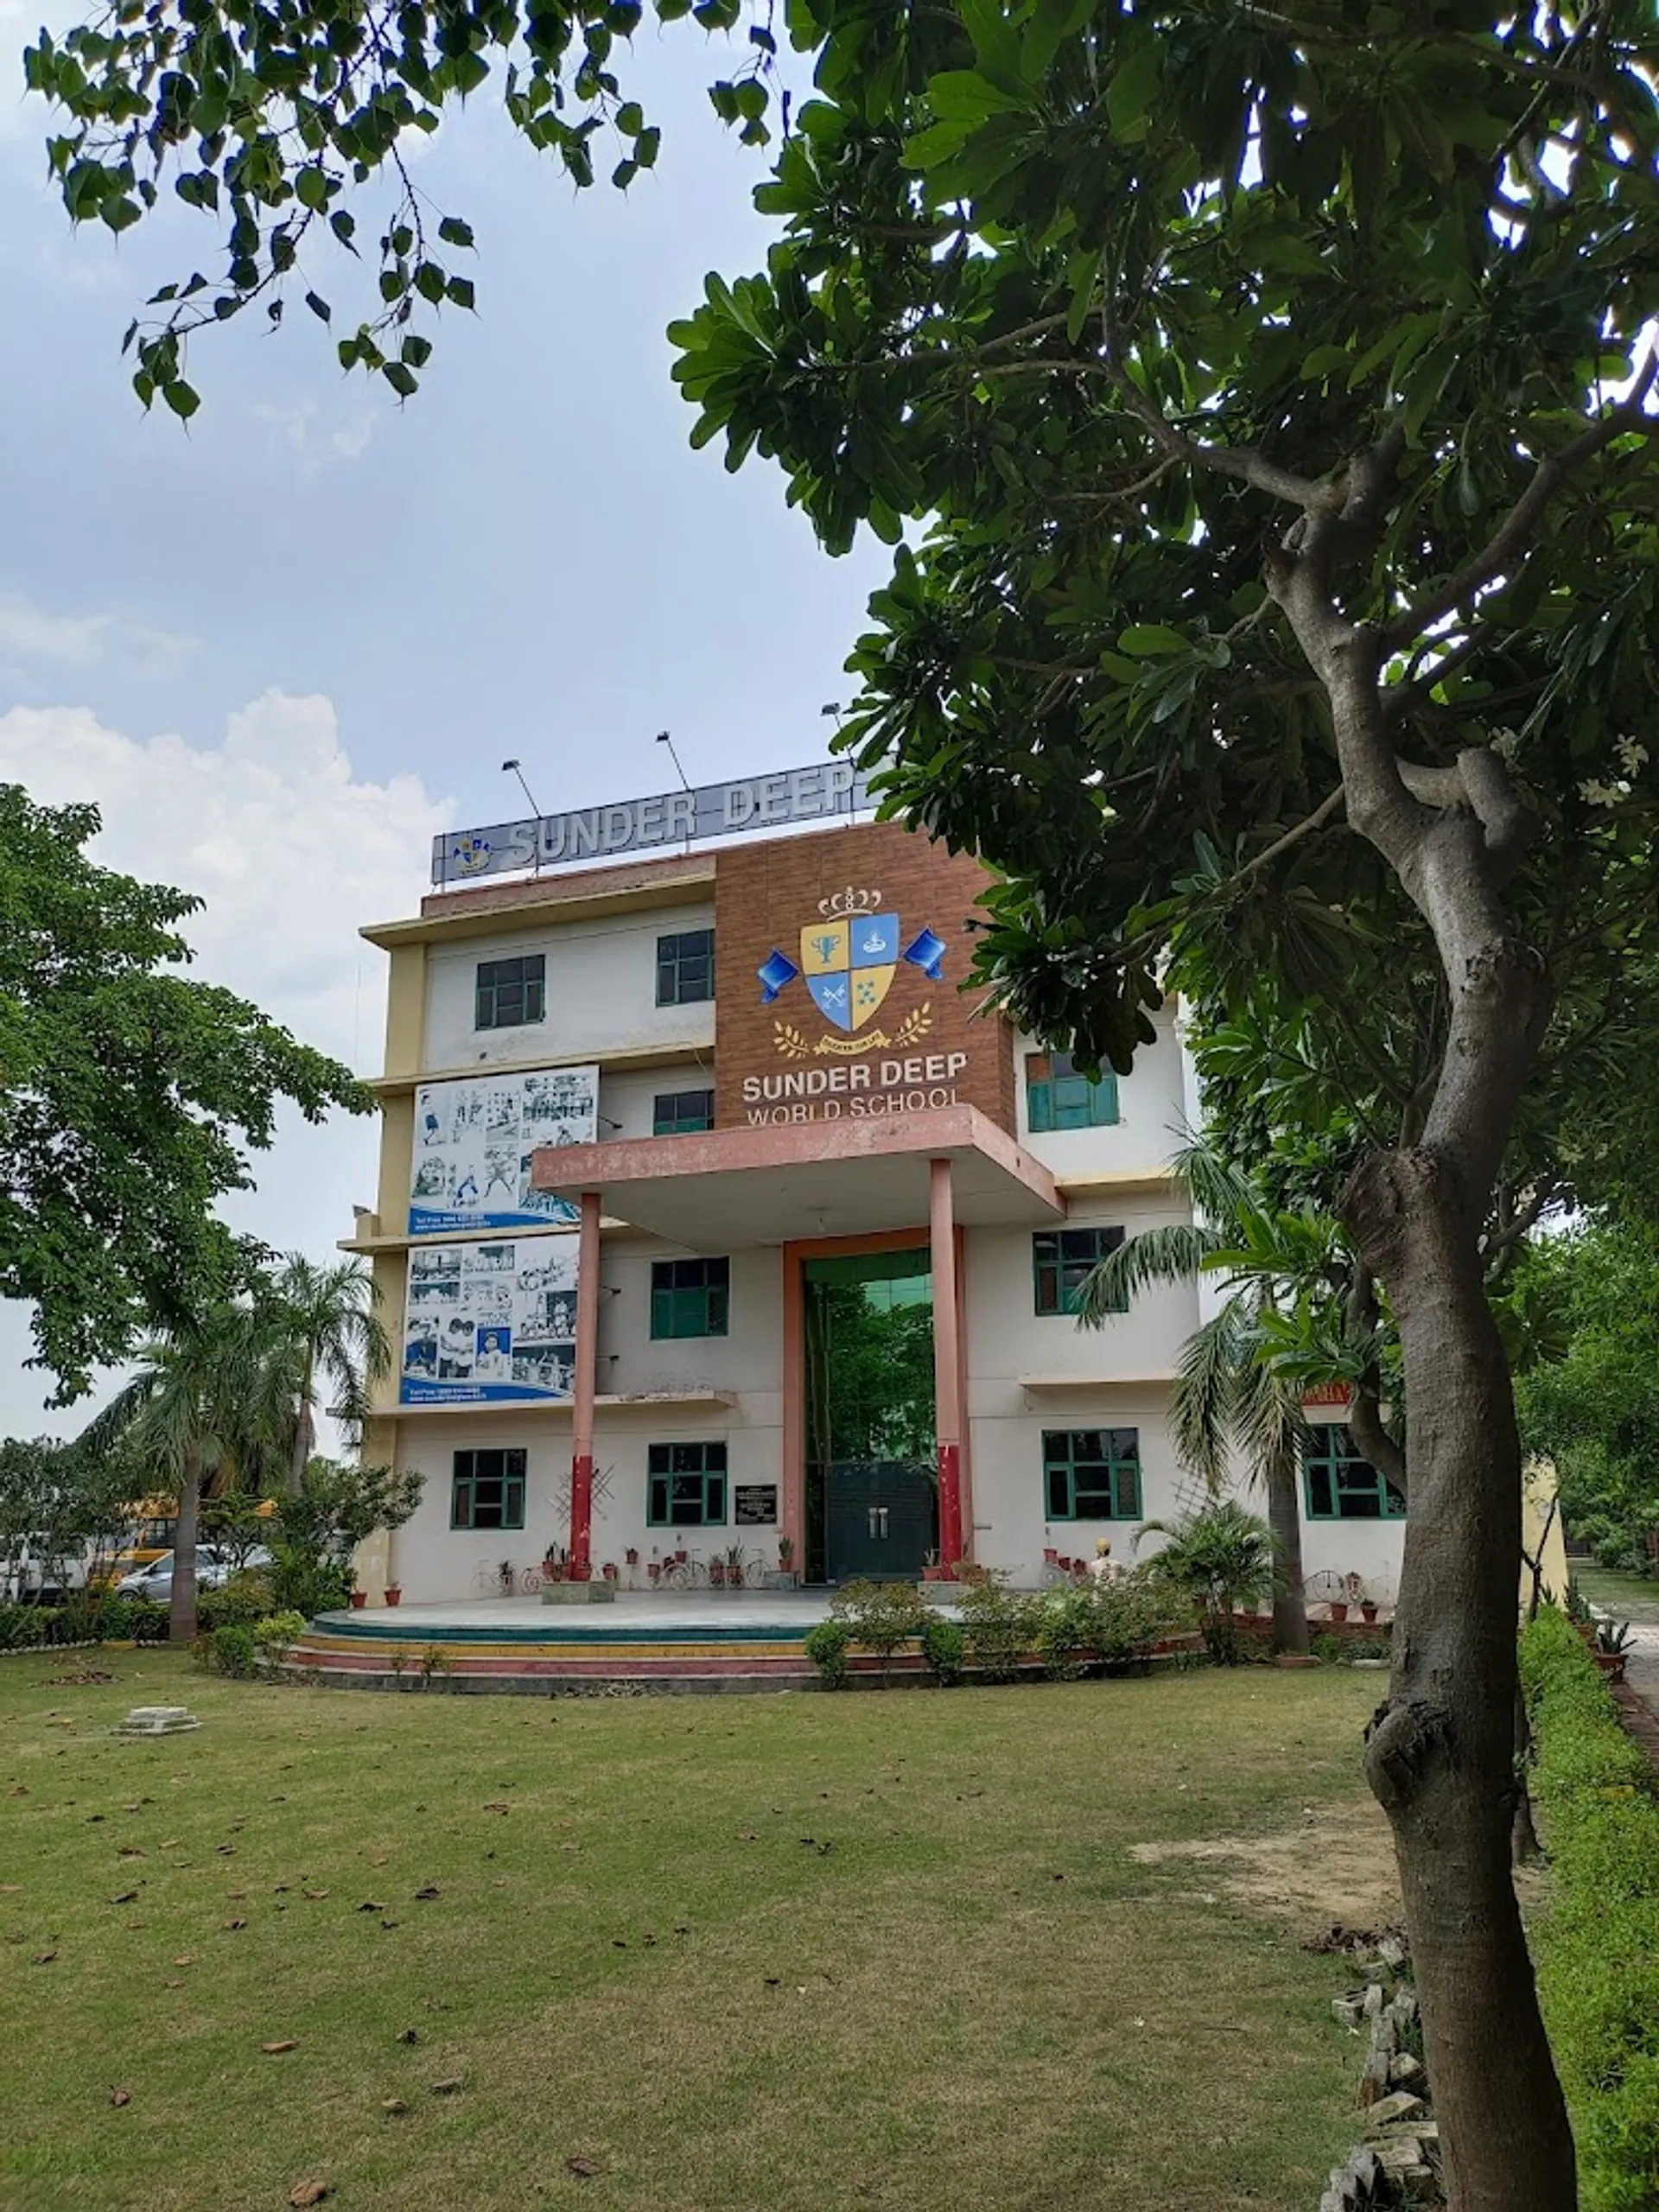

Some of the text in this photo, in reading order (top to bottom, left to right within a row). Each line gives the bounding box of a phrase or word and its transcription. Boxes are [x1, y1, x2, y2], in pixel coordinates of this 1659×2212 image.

[509, 762, 855, 863] SUNDER DEEP
[742, 1052, 967, 1103] SUNDER DEEP
[746, 1087, 957, 1127] WORLD SCHOOL
